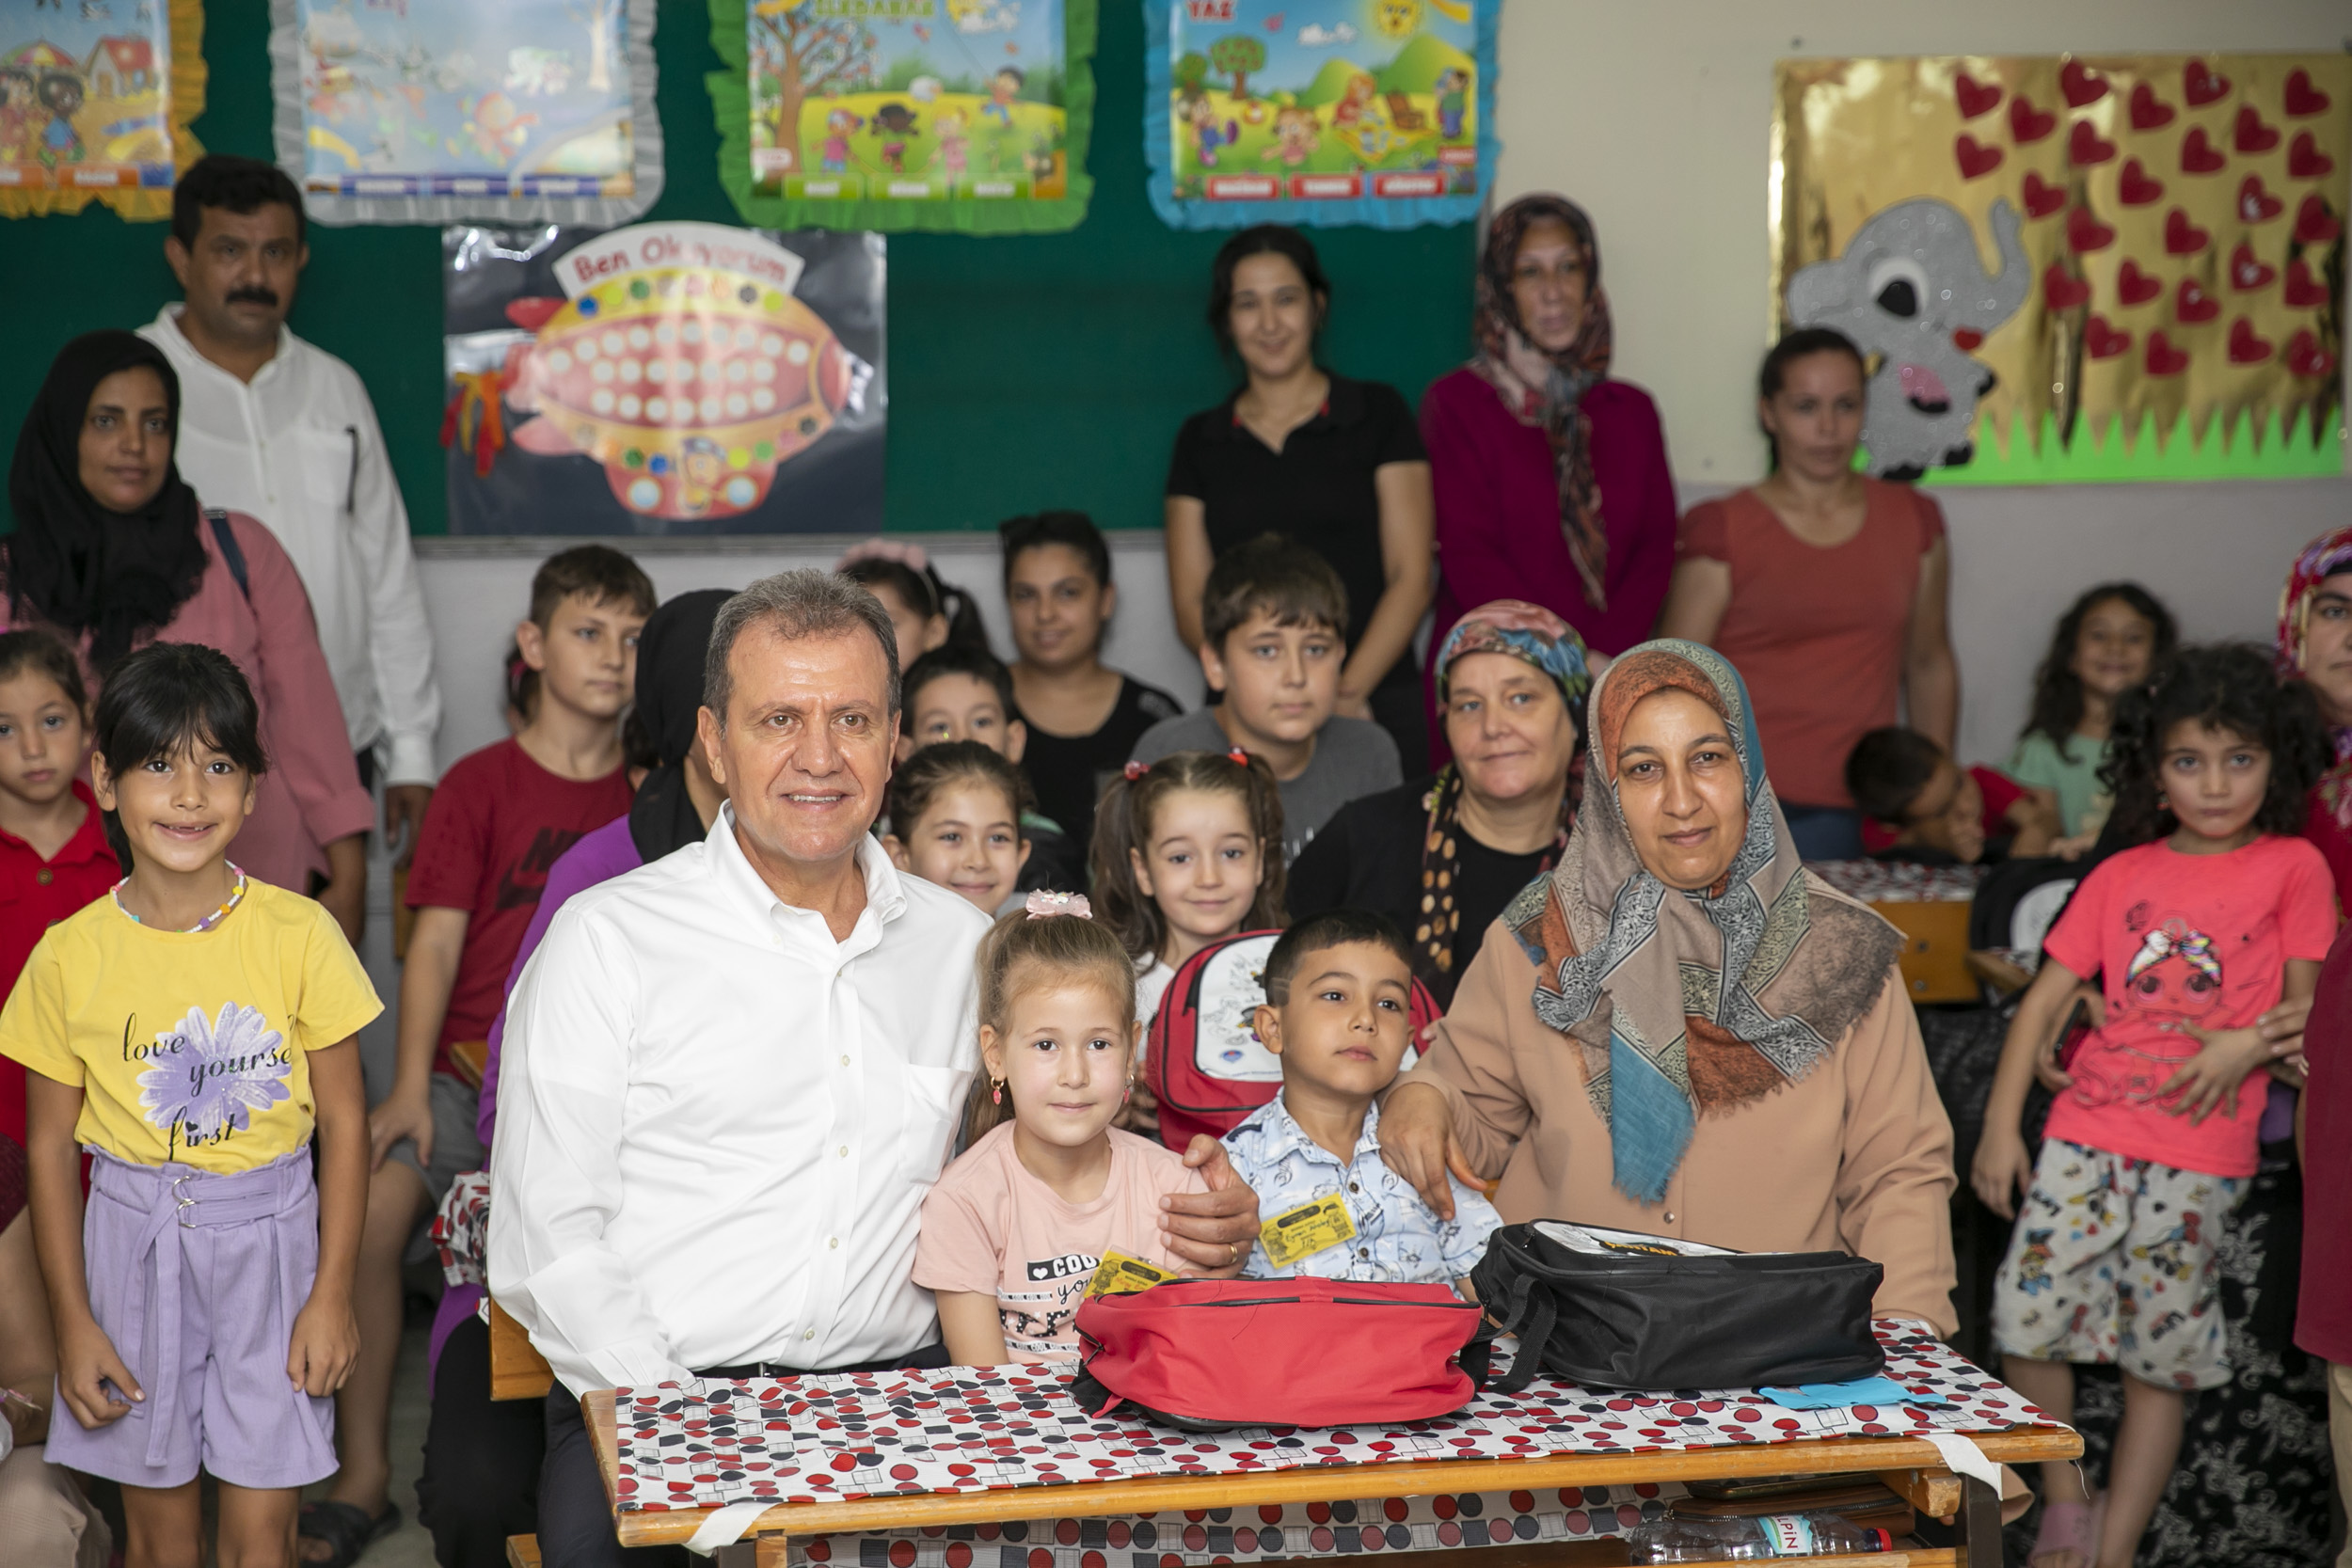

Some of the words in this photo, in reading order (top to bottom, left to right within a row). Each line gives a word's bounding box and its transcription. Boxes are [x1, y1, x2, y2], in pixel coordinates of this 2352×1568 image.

[573, 249, 630, 282] Ben
[123, 1012, 185, 1062] love
[167, 1105, 238, 1162] first
